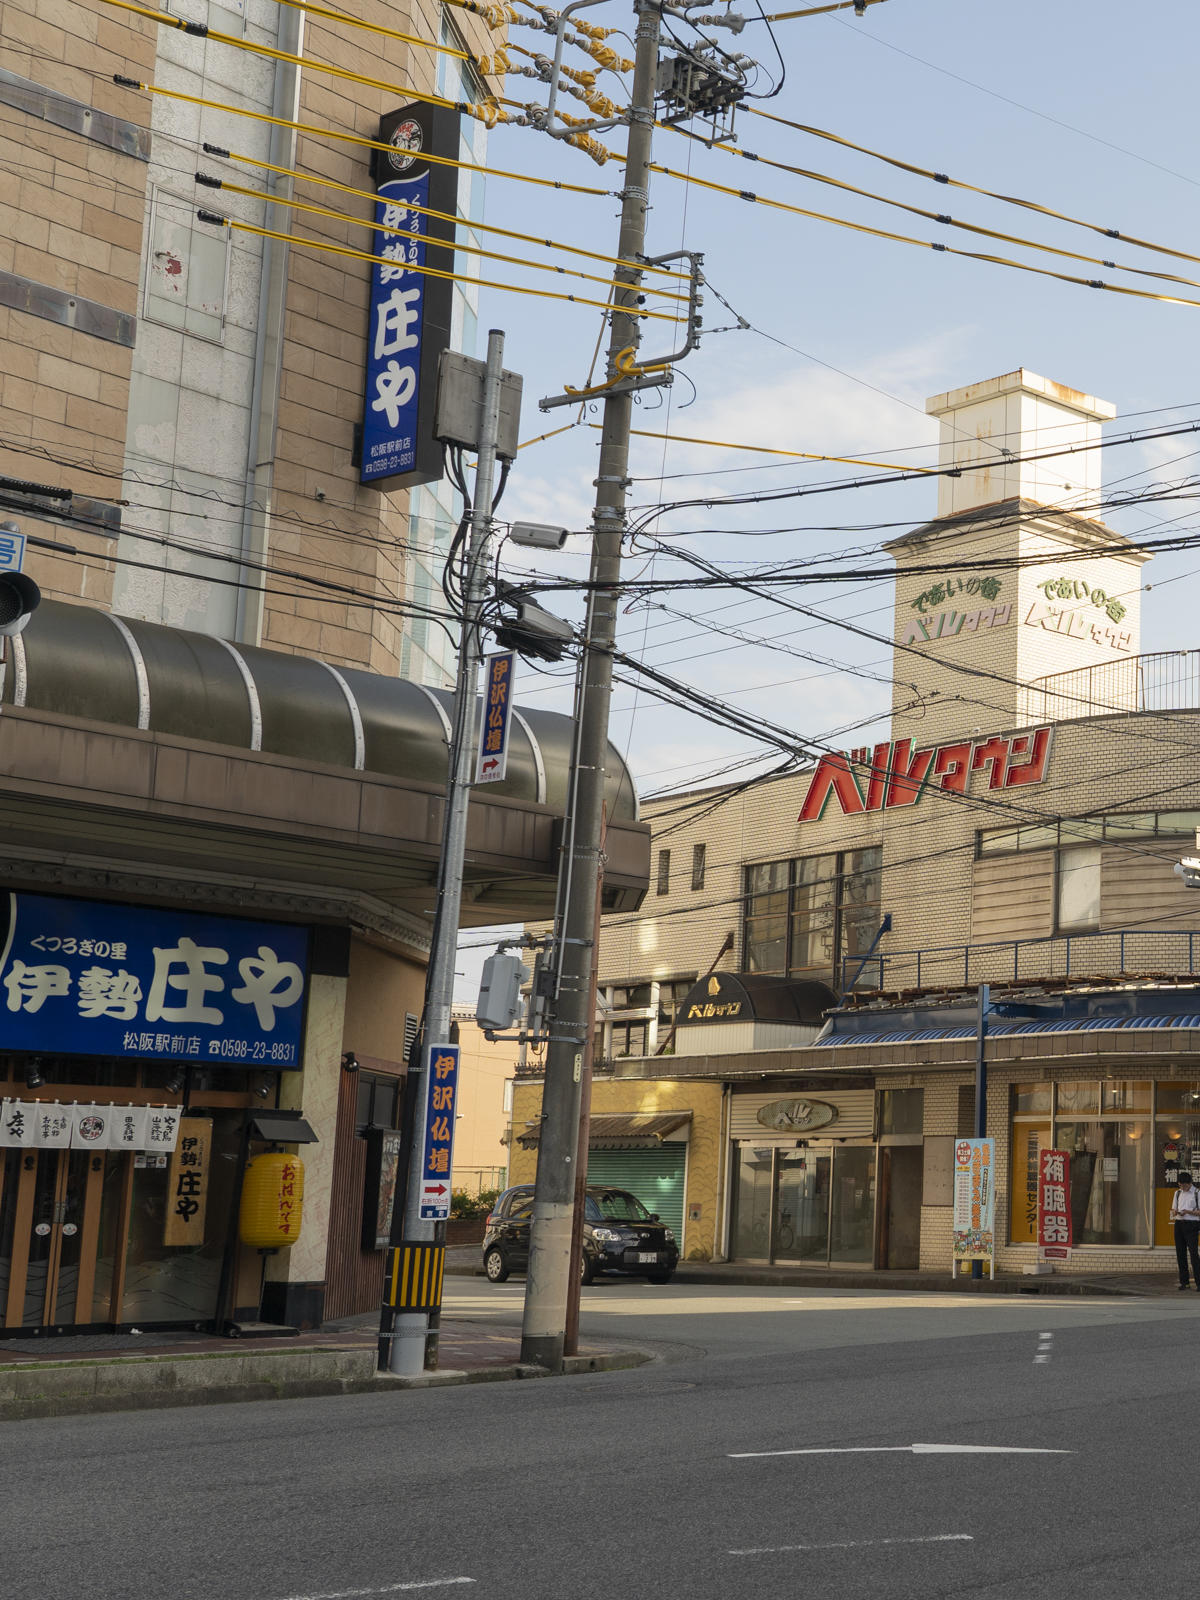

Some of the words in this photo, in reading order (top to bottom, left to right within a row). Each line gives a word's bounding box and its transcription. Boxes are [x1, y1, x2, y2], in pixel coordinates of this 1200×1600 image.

[372, 198, 420, 428] 伊勢庄や
[370, 437, 411, 457] 松阪駅前店
[902, 604, 1012, 644] ベルタウン
[486, 660, 509, 751] 伊沢仏壇
[797, 727, 1052, 823] ベルタウン
[4, 937, 304, 1031] 伊勢庄や
[30, 936, 127, 960] くつろぎの里
[123, 1031, 201, 1055] 松阪駅前店
[221, 1039, 295, 1061] 0598-23-8831
[6, 1111, 25, 1138] 庄や
[428, 1055, 455, 1173] 伊沢仏壇
[176, 1137, 202, 1222] 伊勢庄や
[1043, 1154, 1069, 1242] 補聴器
